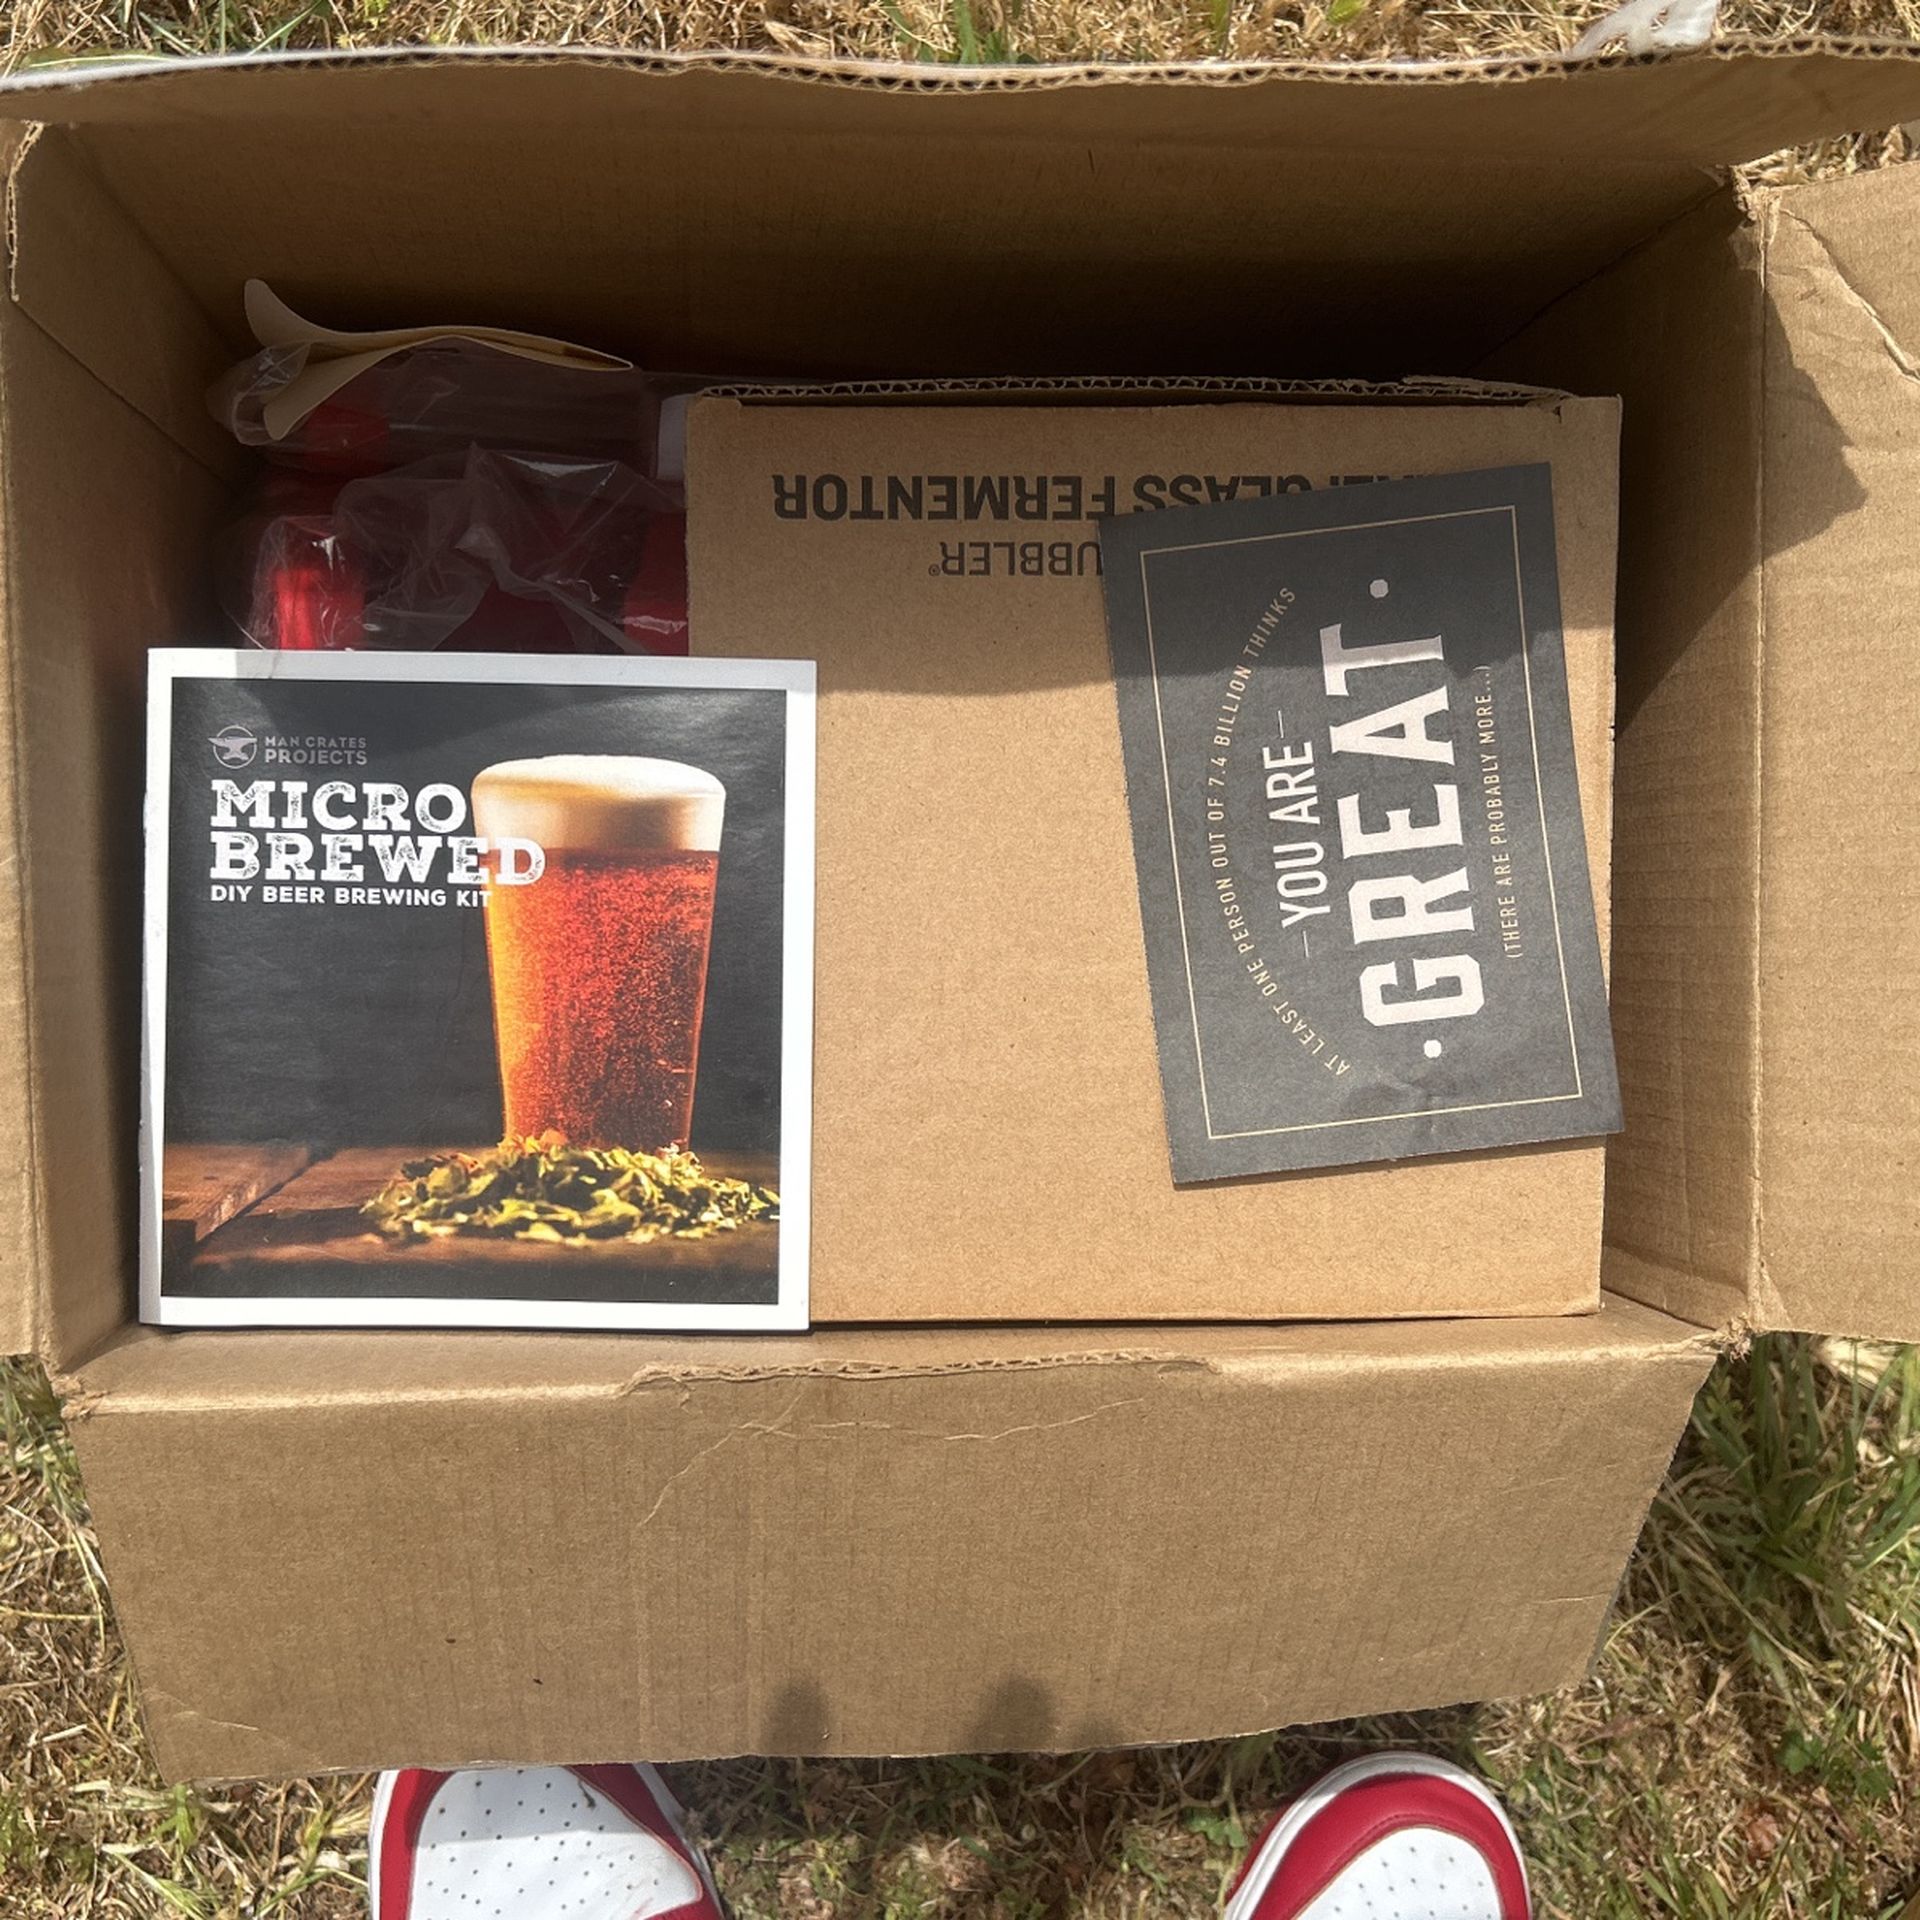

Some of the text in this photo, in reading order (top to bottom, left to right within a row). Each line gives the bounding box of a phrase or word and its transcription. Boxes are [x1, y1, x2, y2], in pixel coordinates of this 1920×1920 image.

[771, 474, 1116, 521] FERMENTOR
[264, 735, 368, 750] MAN CRATES
[264, 749, 369, 767] PROJECTS
[209, 778, 468, 834] MICRO
[1207, 587, 1351, 1077] AT LEAST ONE PERSON OUT OF 7.4 BILLION THINKS
[1319, 622, 1486, 1027] GREAT
[1473, 665, 1524, 959] (THERE ARE PROBABLY MORE...)
[209, 830, 547, 887] BREWED
[1262, 740, 1332, 929] YOU ARE
[210, 884, 493, 908] DIY BEER BREWING KIT
